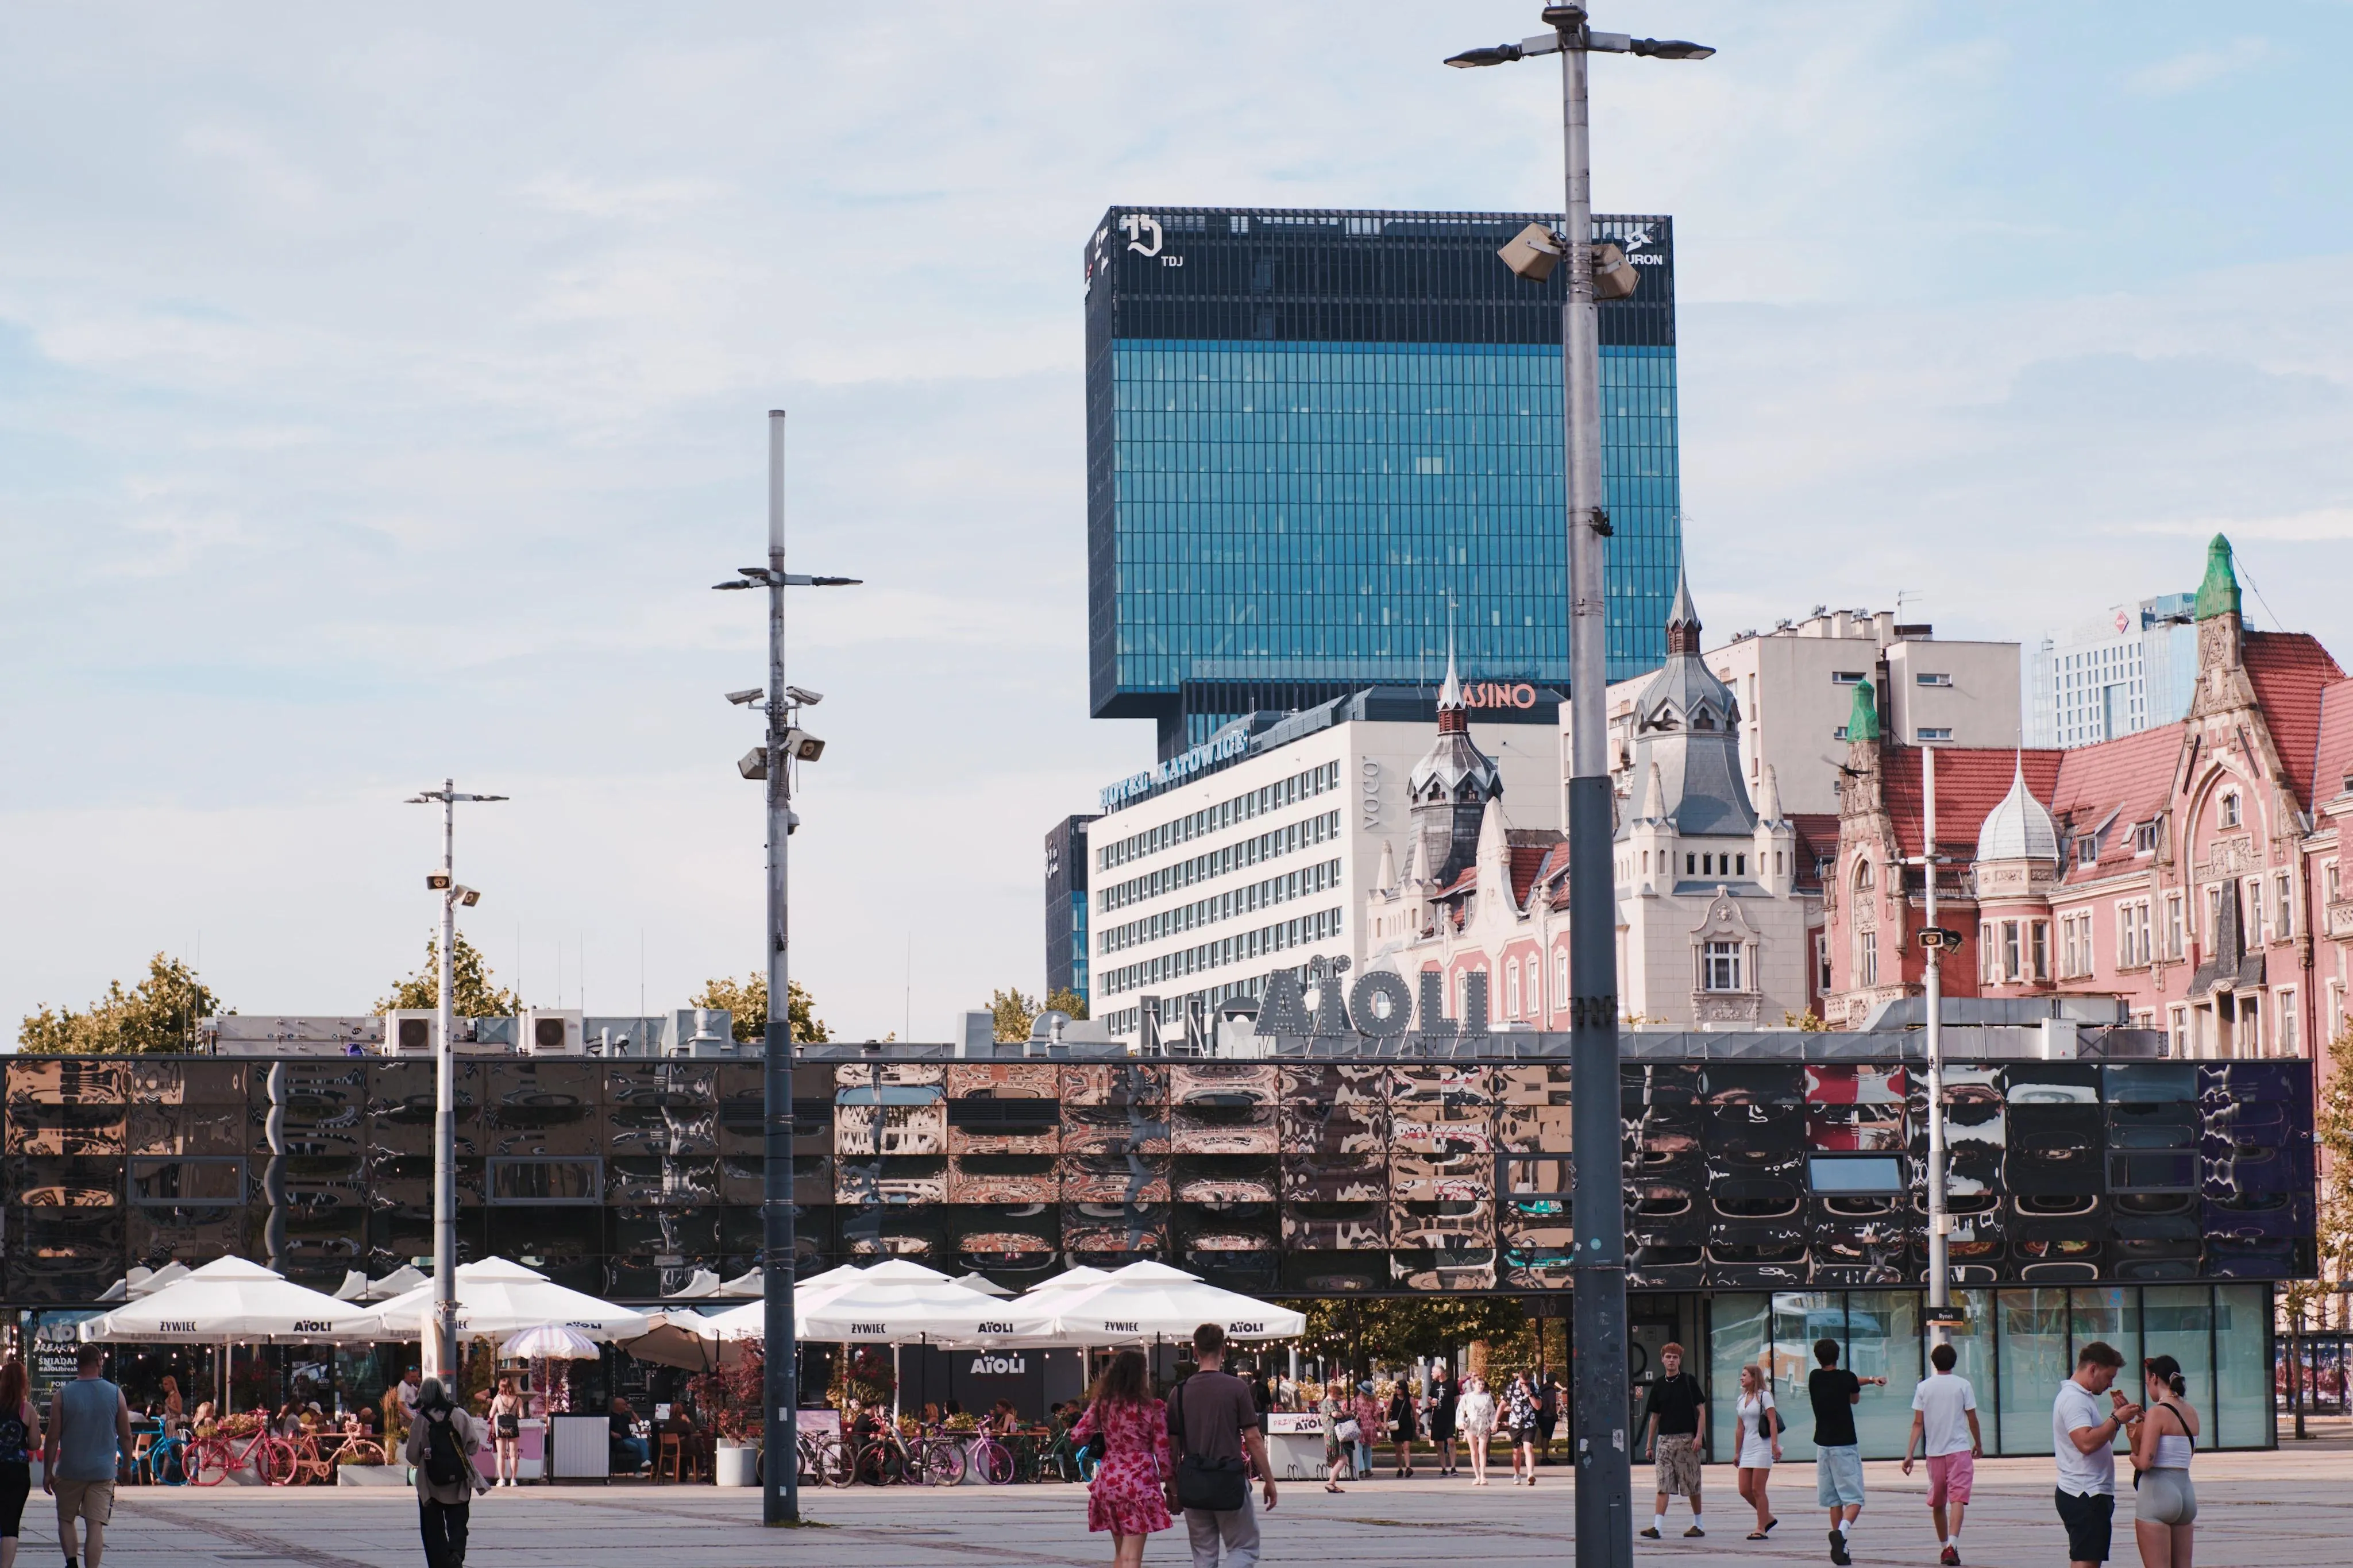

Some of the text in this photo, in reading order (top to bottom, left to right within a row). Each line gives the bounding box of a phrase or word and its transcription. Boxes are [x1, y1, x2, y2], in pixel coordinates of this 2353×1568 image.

[1161, 256, 1183, 267] TDJ
[1626, 254, 1662, 265] URON
[1438, 683, 1536, 709] ASINO
[1099, 728, 1247, 809] HOTEL KATOWICE
[160, 1320, 196, 1332] ŻYWIEC
[456, 1320, 468, 1330] IEC
[851, 1323, 885, 1333] ŻYWIEC
[1105, 1321, 1139, 1331] ŻYWIEC
[33, 1343, 80, 1353] BREAKFA
[38, 1355, 78, 1365] ŚNIADAN
